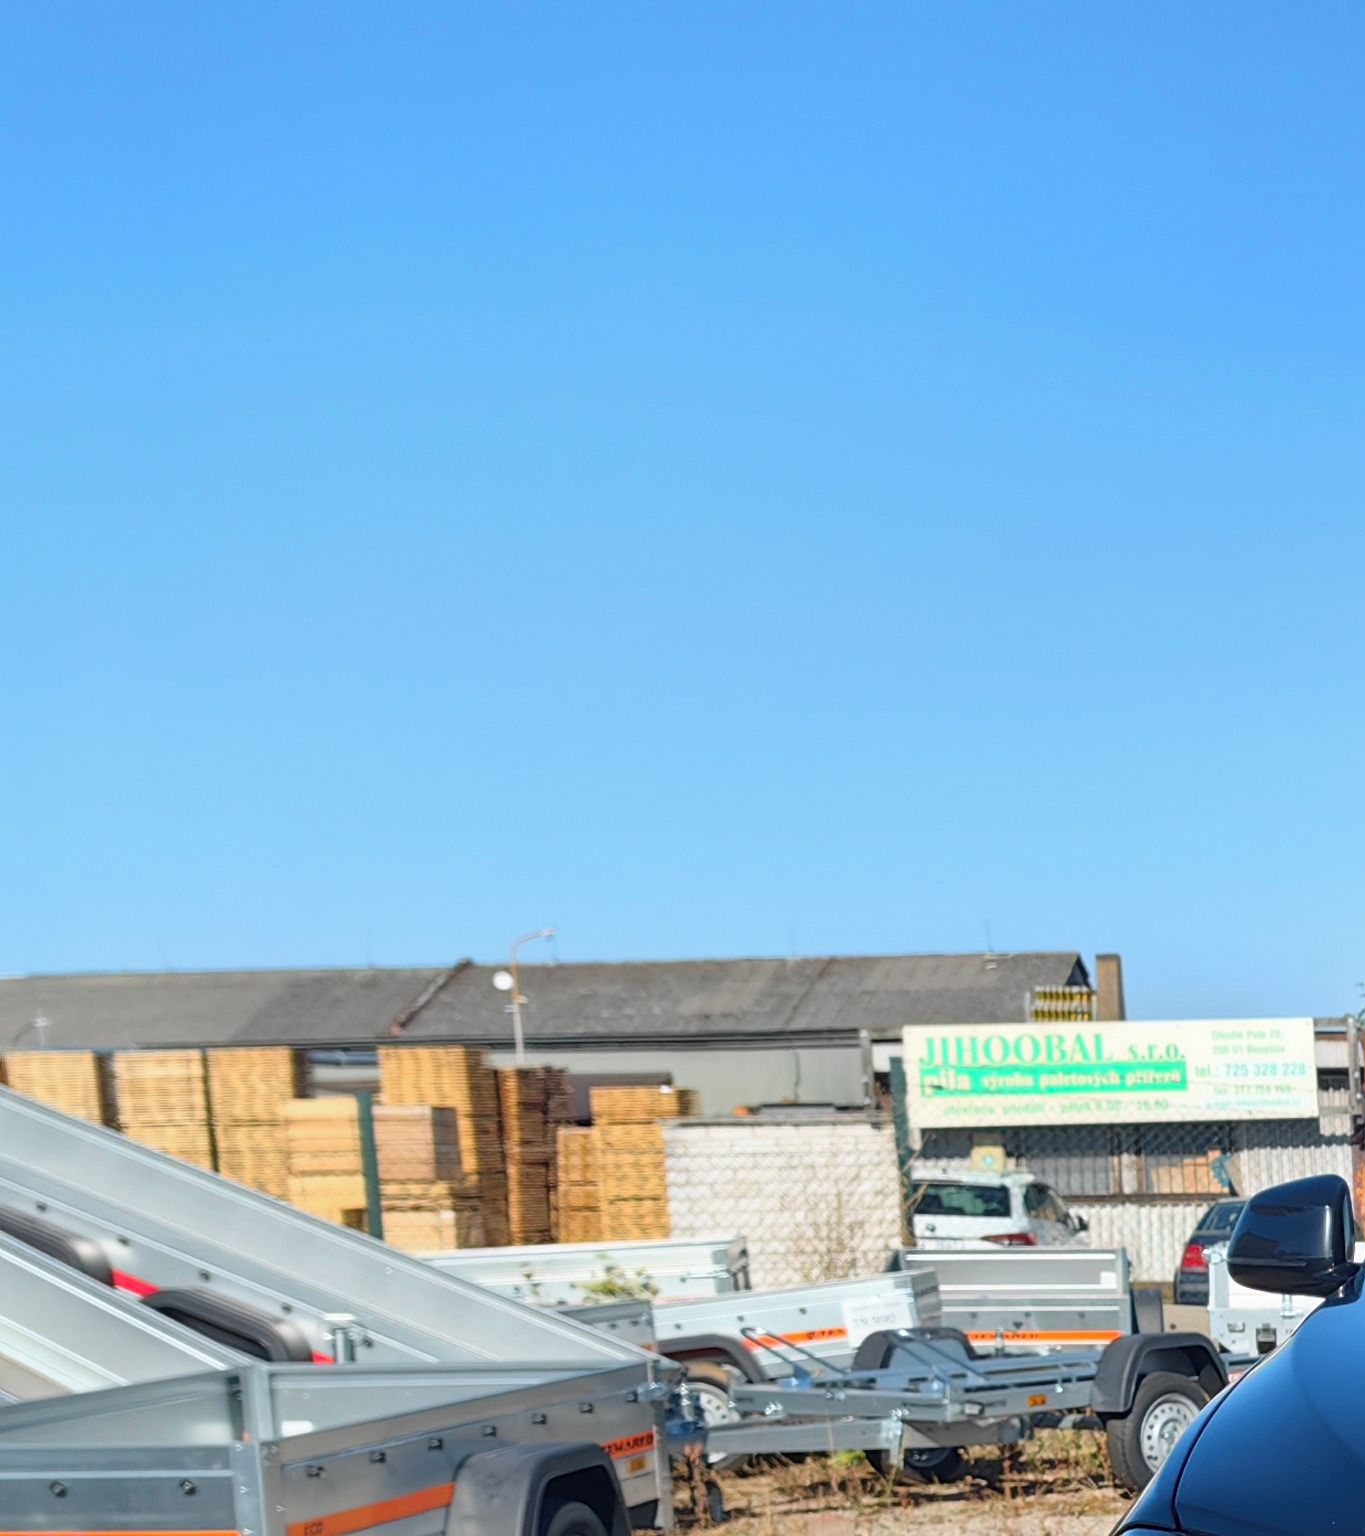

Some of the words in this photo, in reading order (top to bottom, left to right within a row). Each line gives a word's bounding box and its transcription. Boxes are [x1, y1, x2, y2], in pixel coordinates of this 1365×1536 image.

[919, 1032, 1115, 1068] JIHOOBAL
[1128, 1043, 1186, 1060] s.r.o.
[923, 1067, 972, 1097] pila
